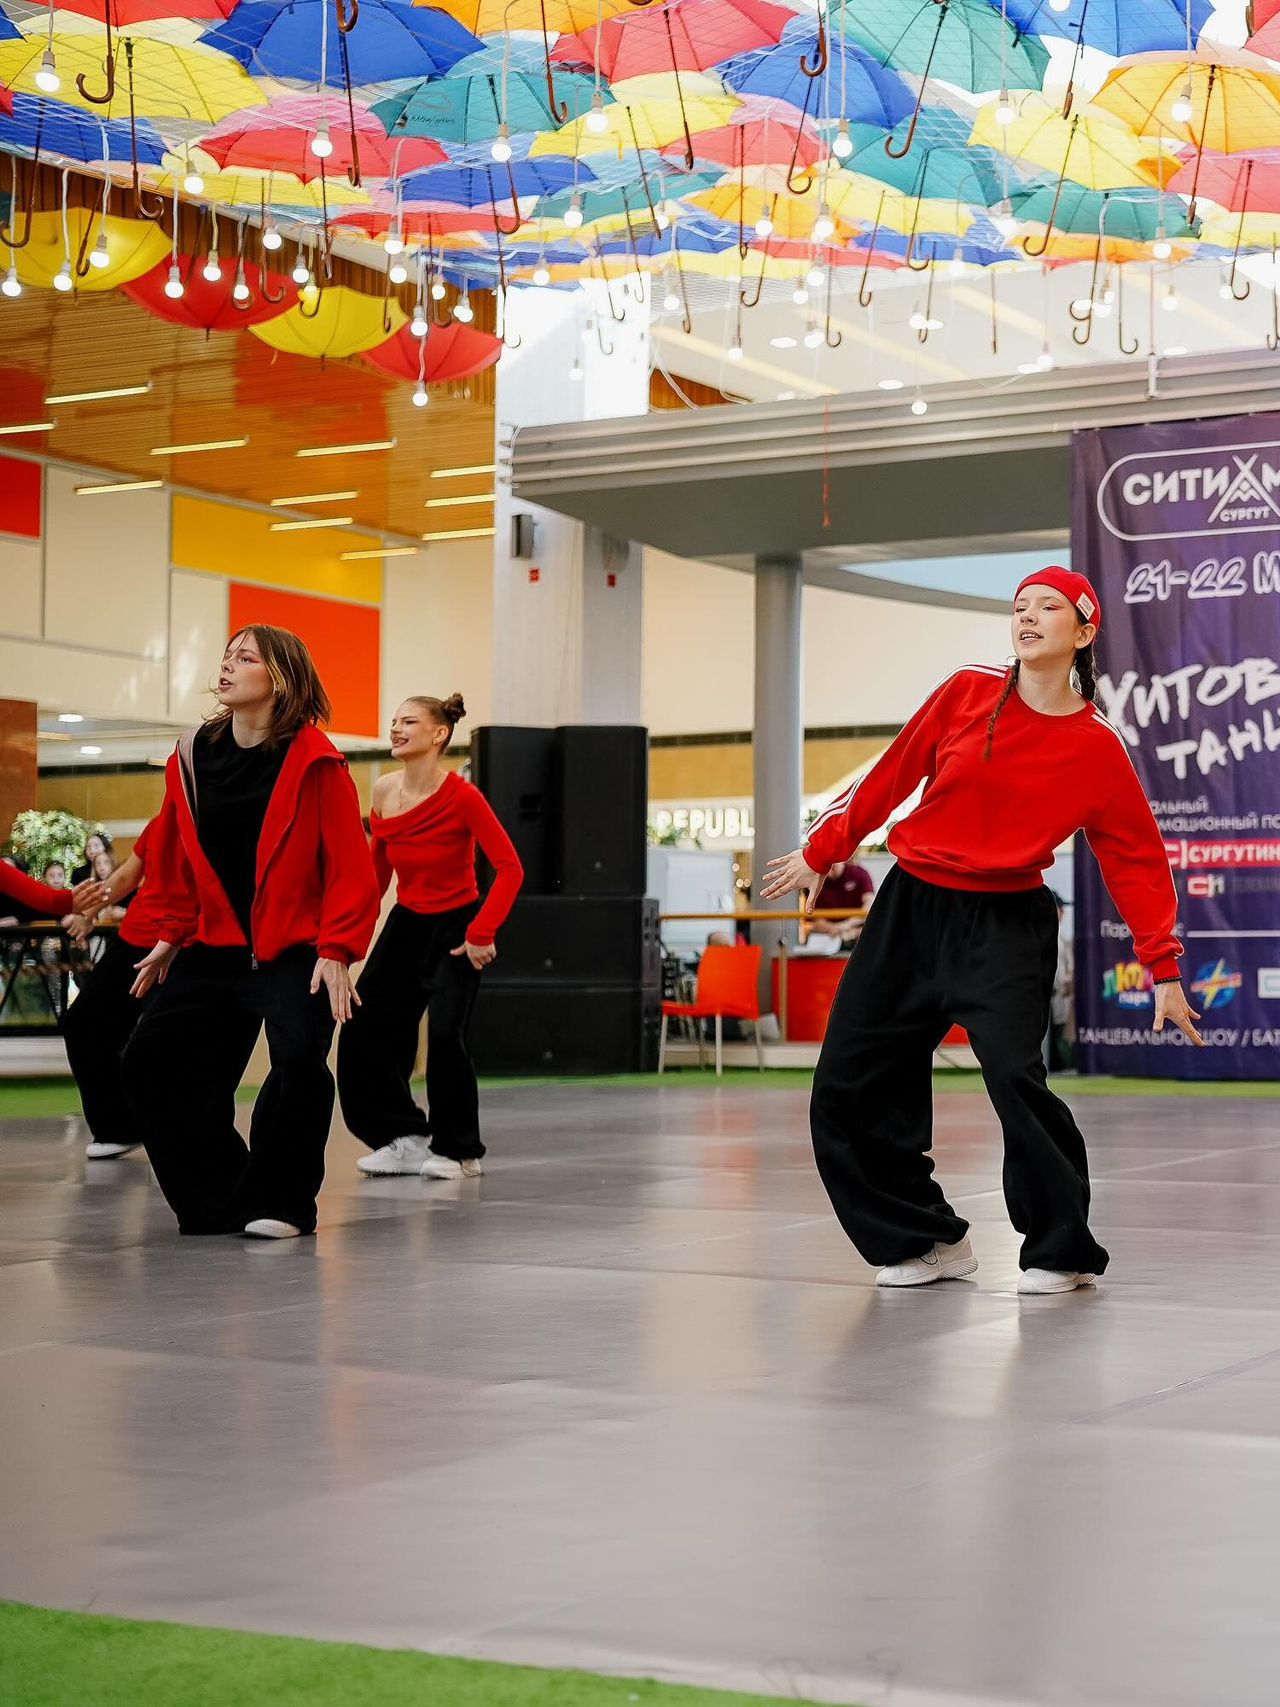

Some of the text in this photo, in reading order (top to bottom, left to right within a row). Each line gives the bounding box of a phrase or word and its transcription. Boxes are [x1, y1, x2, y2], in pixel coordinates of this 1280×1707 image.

[1122, 464, 1230, 506] СИТИ
[1219, 505, 1271, 523] СУРГУТ
[1124, 556, 1248, 603] 21-22
